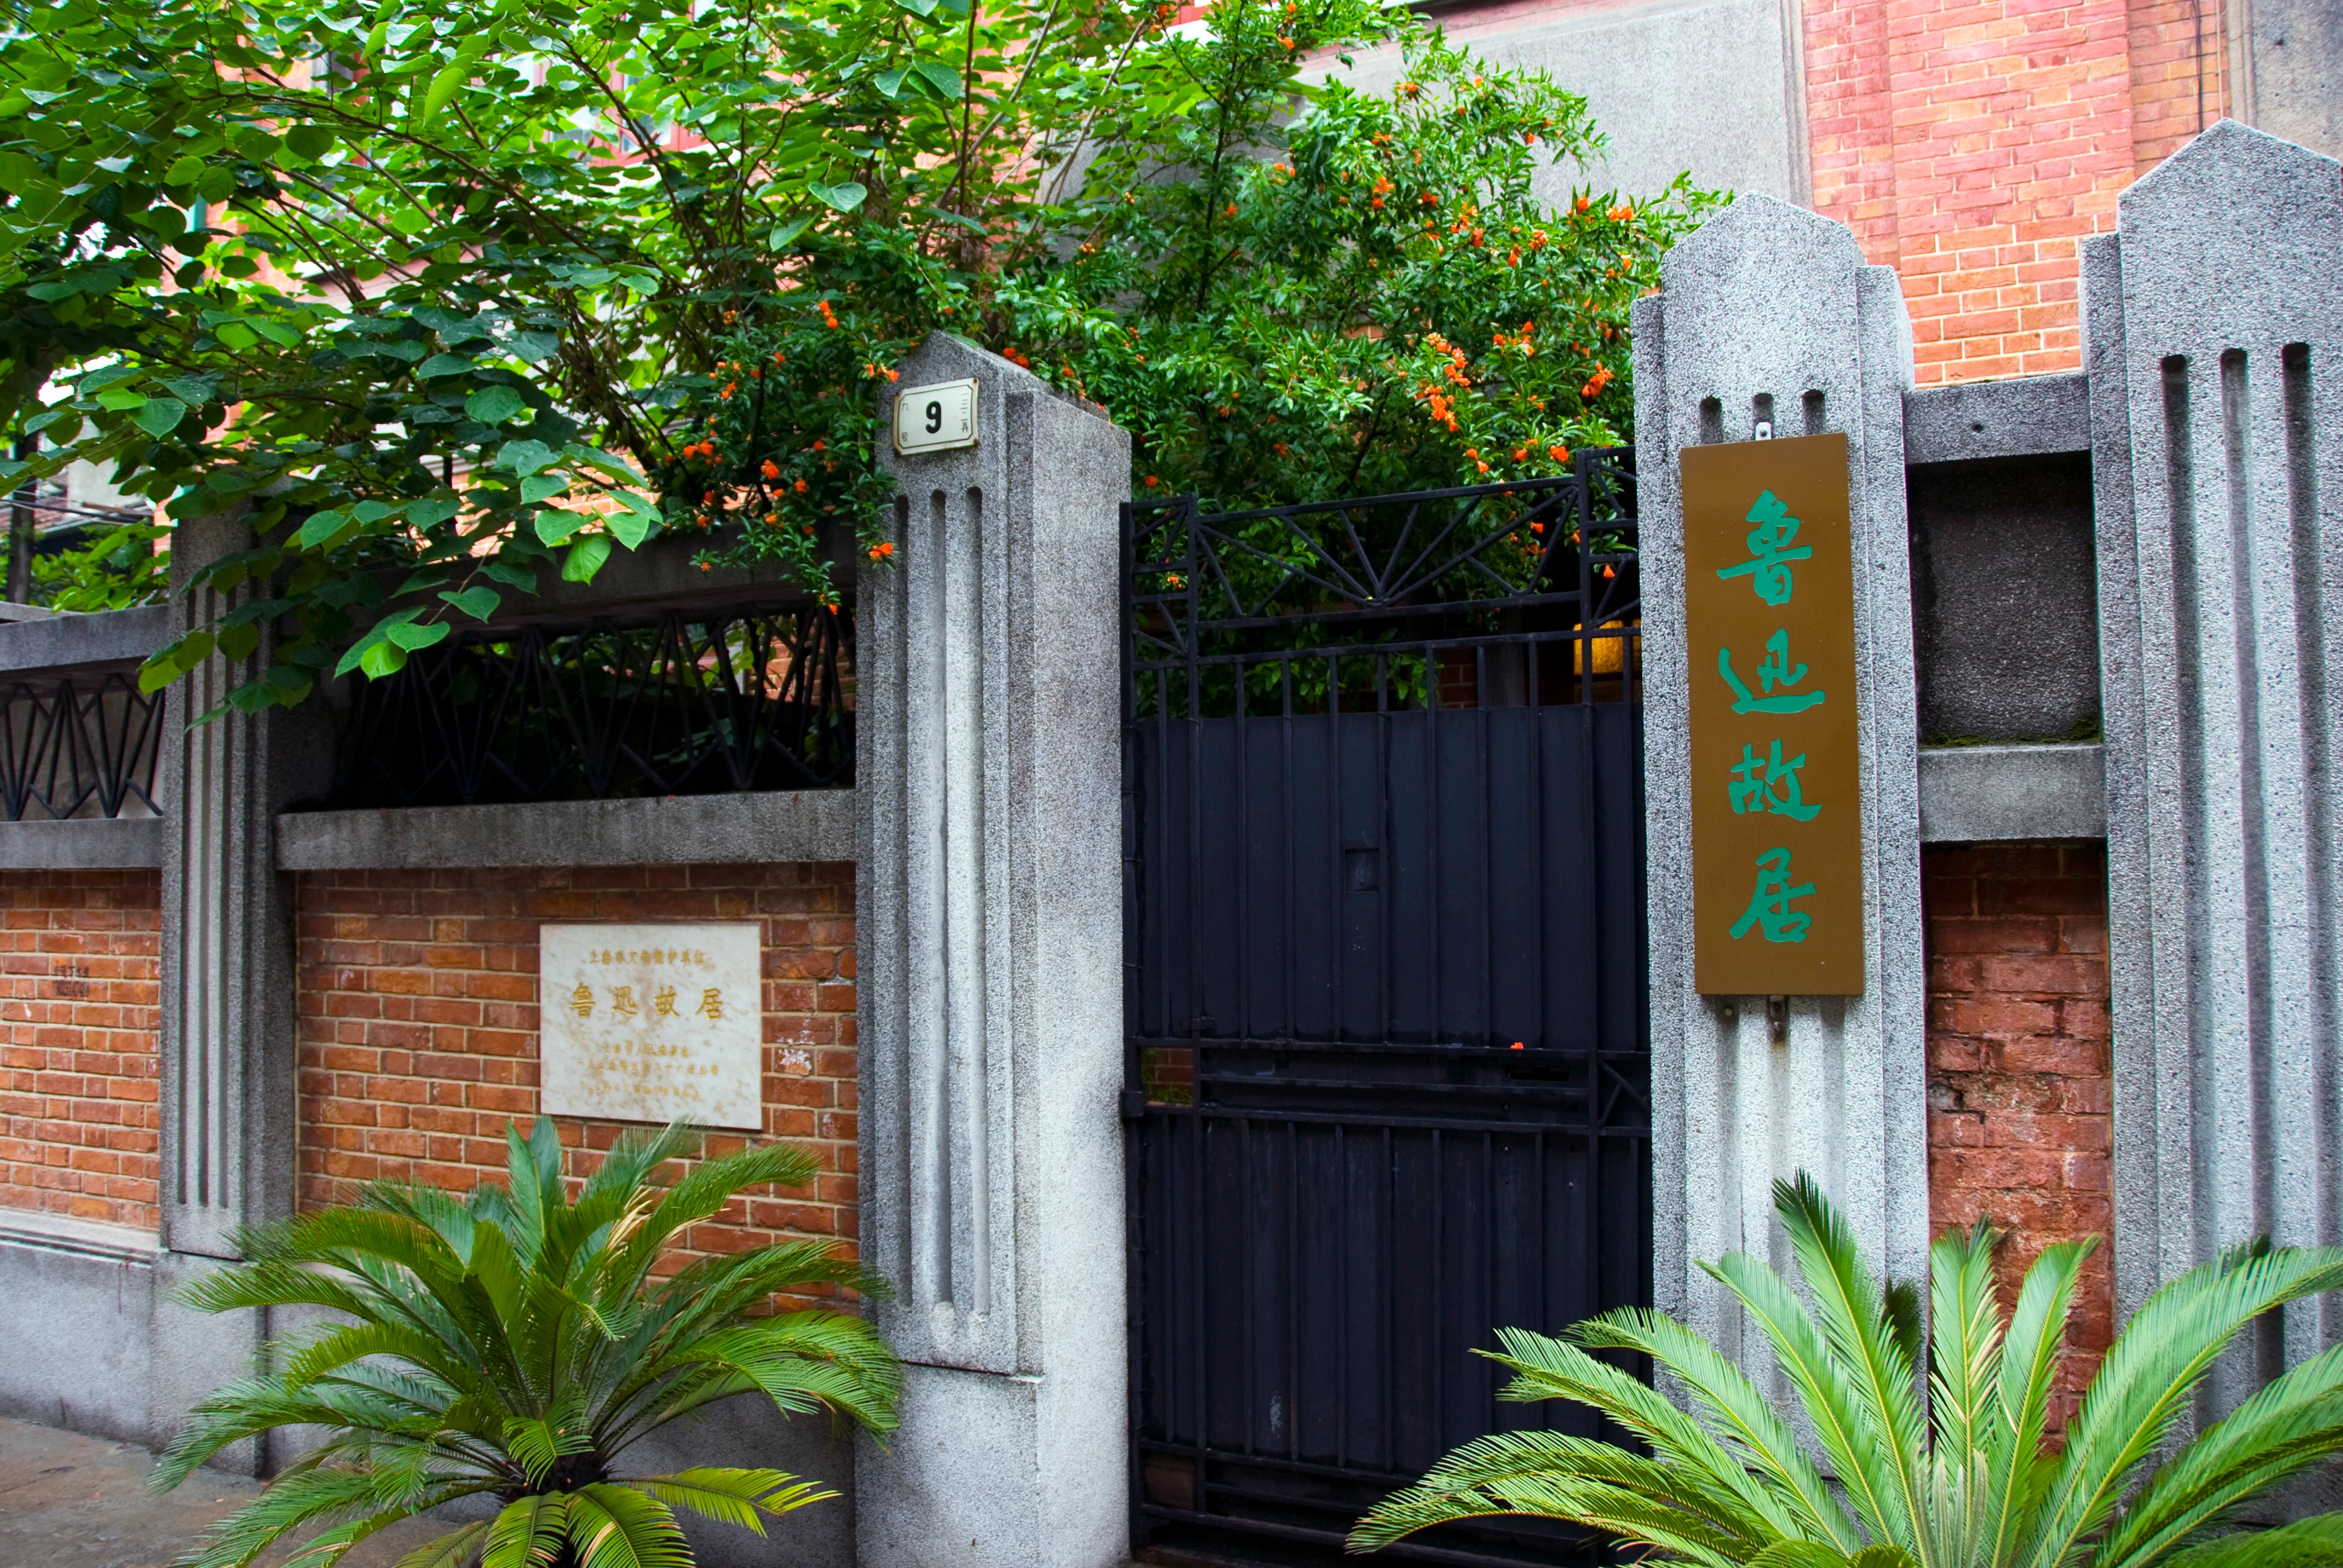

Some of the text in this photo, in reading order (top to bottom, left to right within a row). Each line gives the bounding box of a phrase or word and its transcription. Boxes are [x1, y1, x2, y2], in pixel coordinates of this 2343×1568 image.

[926, 400, 942, 434] 9
[1717, 489, 1825, 943] 鲁迅故居
[570, 982, 723, 1021] 鲁迅故居
